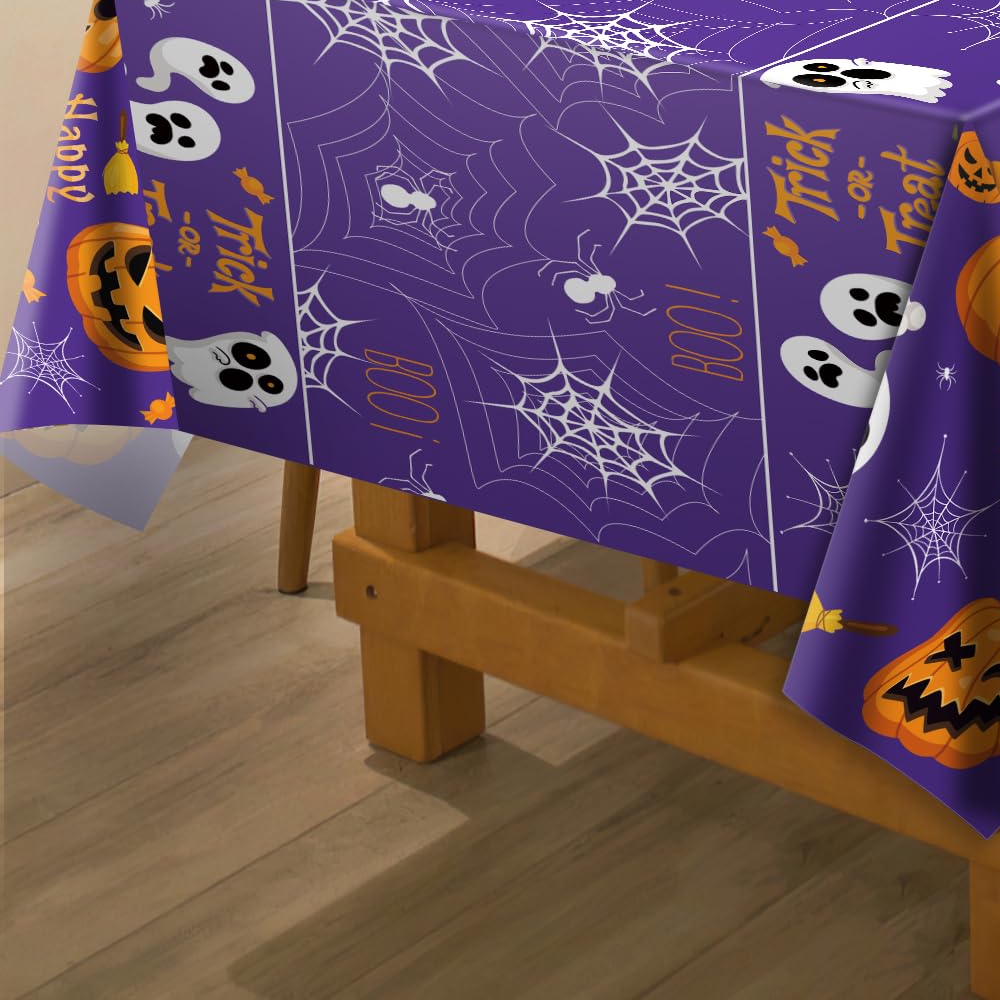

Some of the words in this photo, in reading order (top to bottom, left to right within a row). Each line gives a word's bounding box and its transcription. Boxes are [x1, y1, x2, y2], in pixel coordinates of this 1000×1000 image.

[47, 93, 99, 203] Happy
[764, 114, 841, 225] Trick
[878, 144, 945, 255] Treat
[206, 207, 275, 307] Trick
[664, 284, 744, 382] BOO!
[364, 348, 440, 444] BOO!
